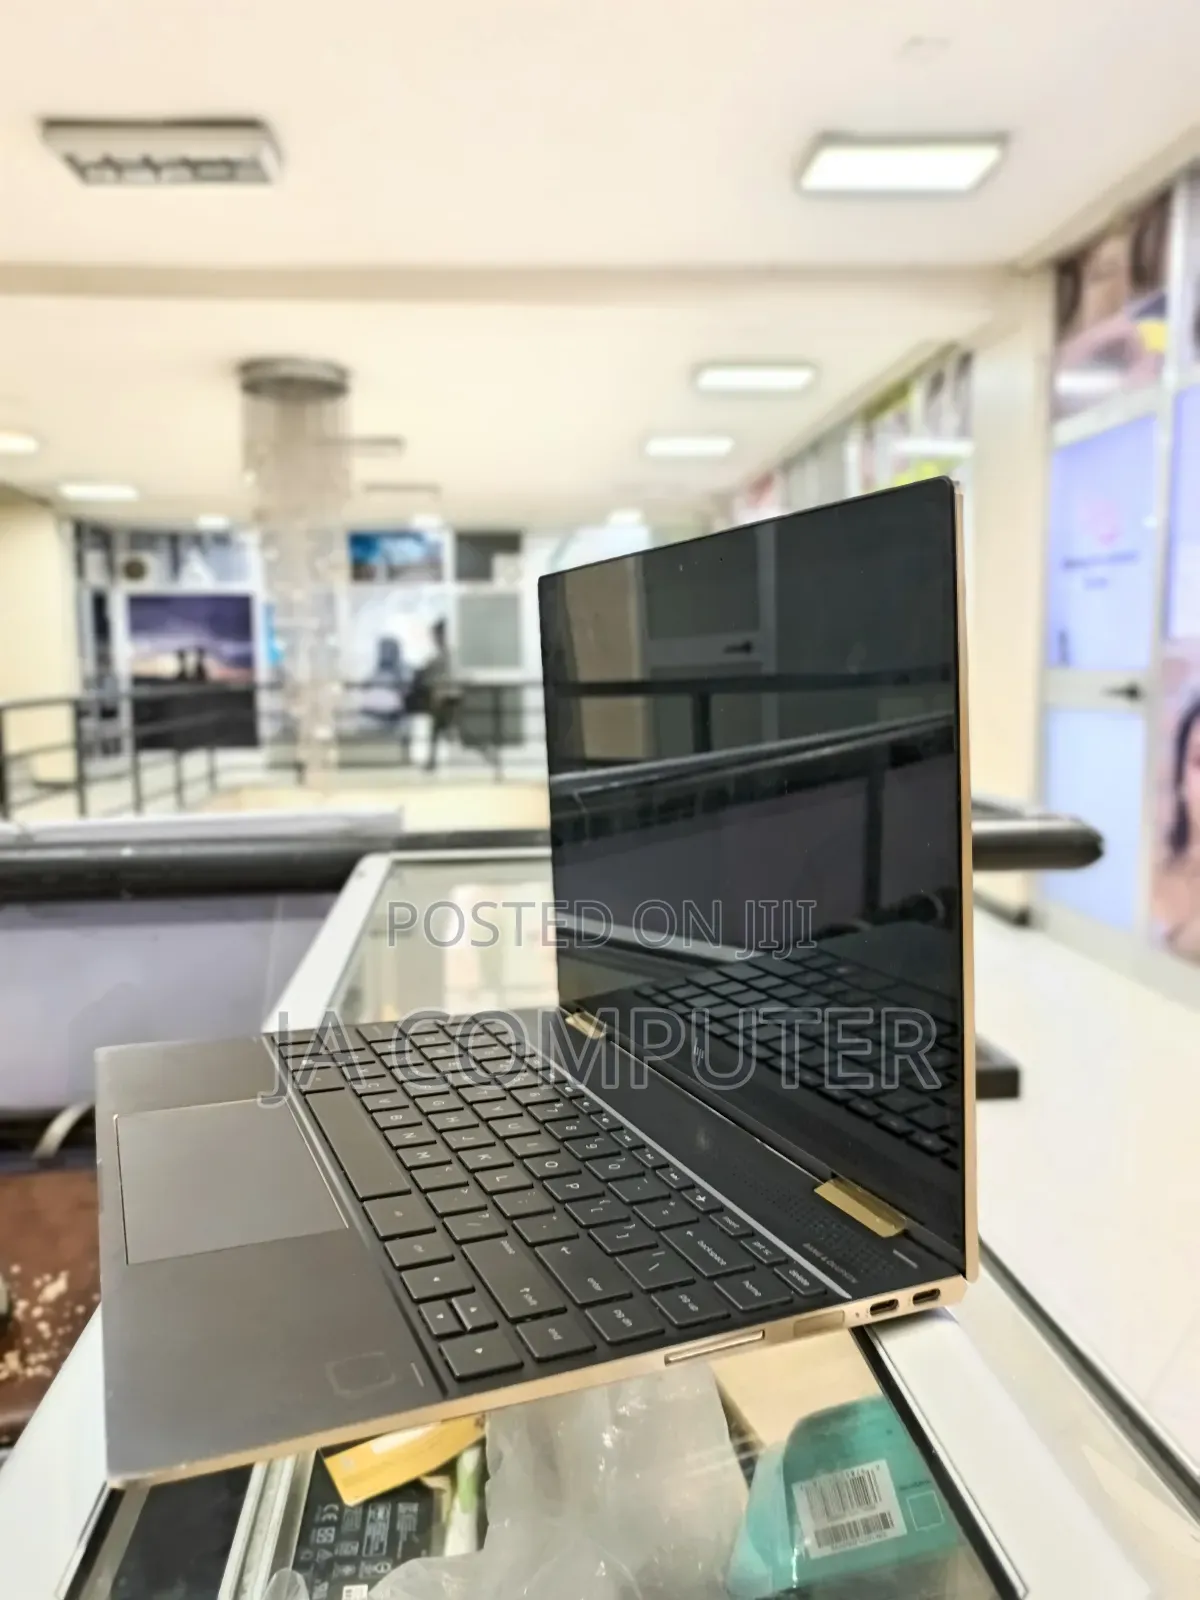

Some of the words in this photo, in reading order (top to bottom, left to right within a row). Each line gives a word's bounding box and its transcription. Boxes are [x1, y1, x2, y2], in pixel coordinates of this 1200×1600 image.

[417, 1151, 431, 1159] M
[545, 1160, 559, 1168] O
[565, 1182, 580, 1190] P
[697, 1240, 727, 1266] backspace
[587, 1277, 603, 1291] enter
[741, 1280, 762, 1297] home
[547, 1328, 563, 1341] end
